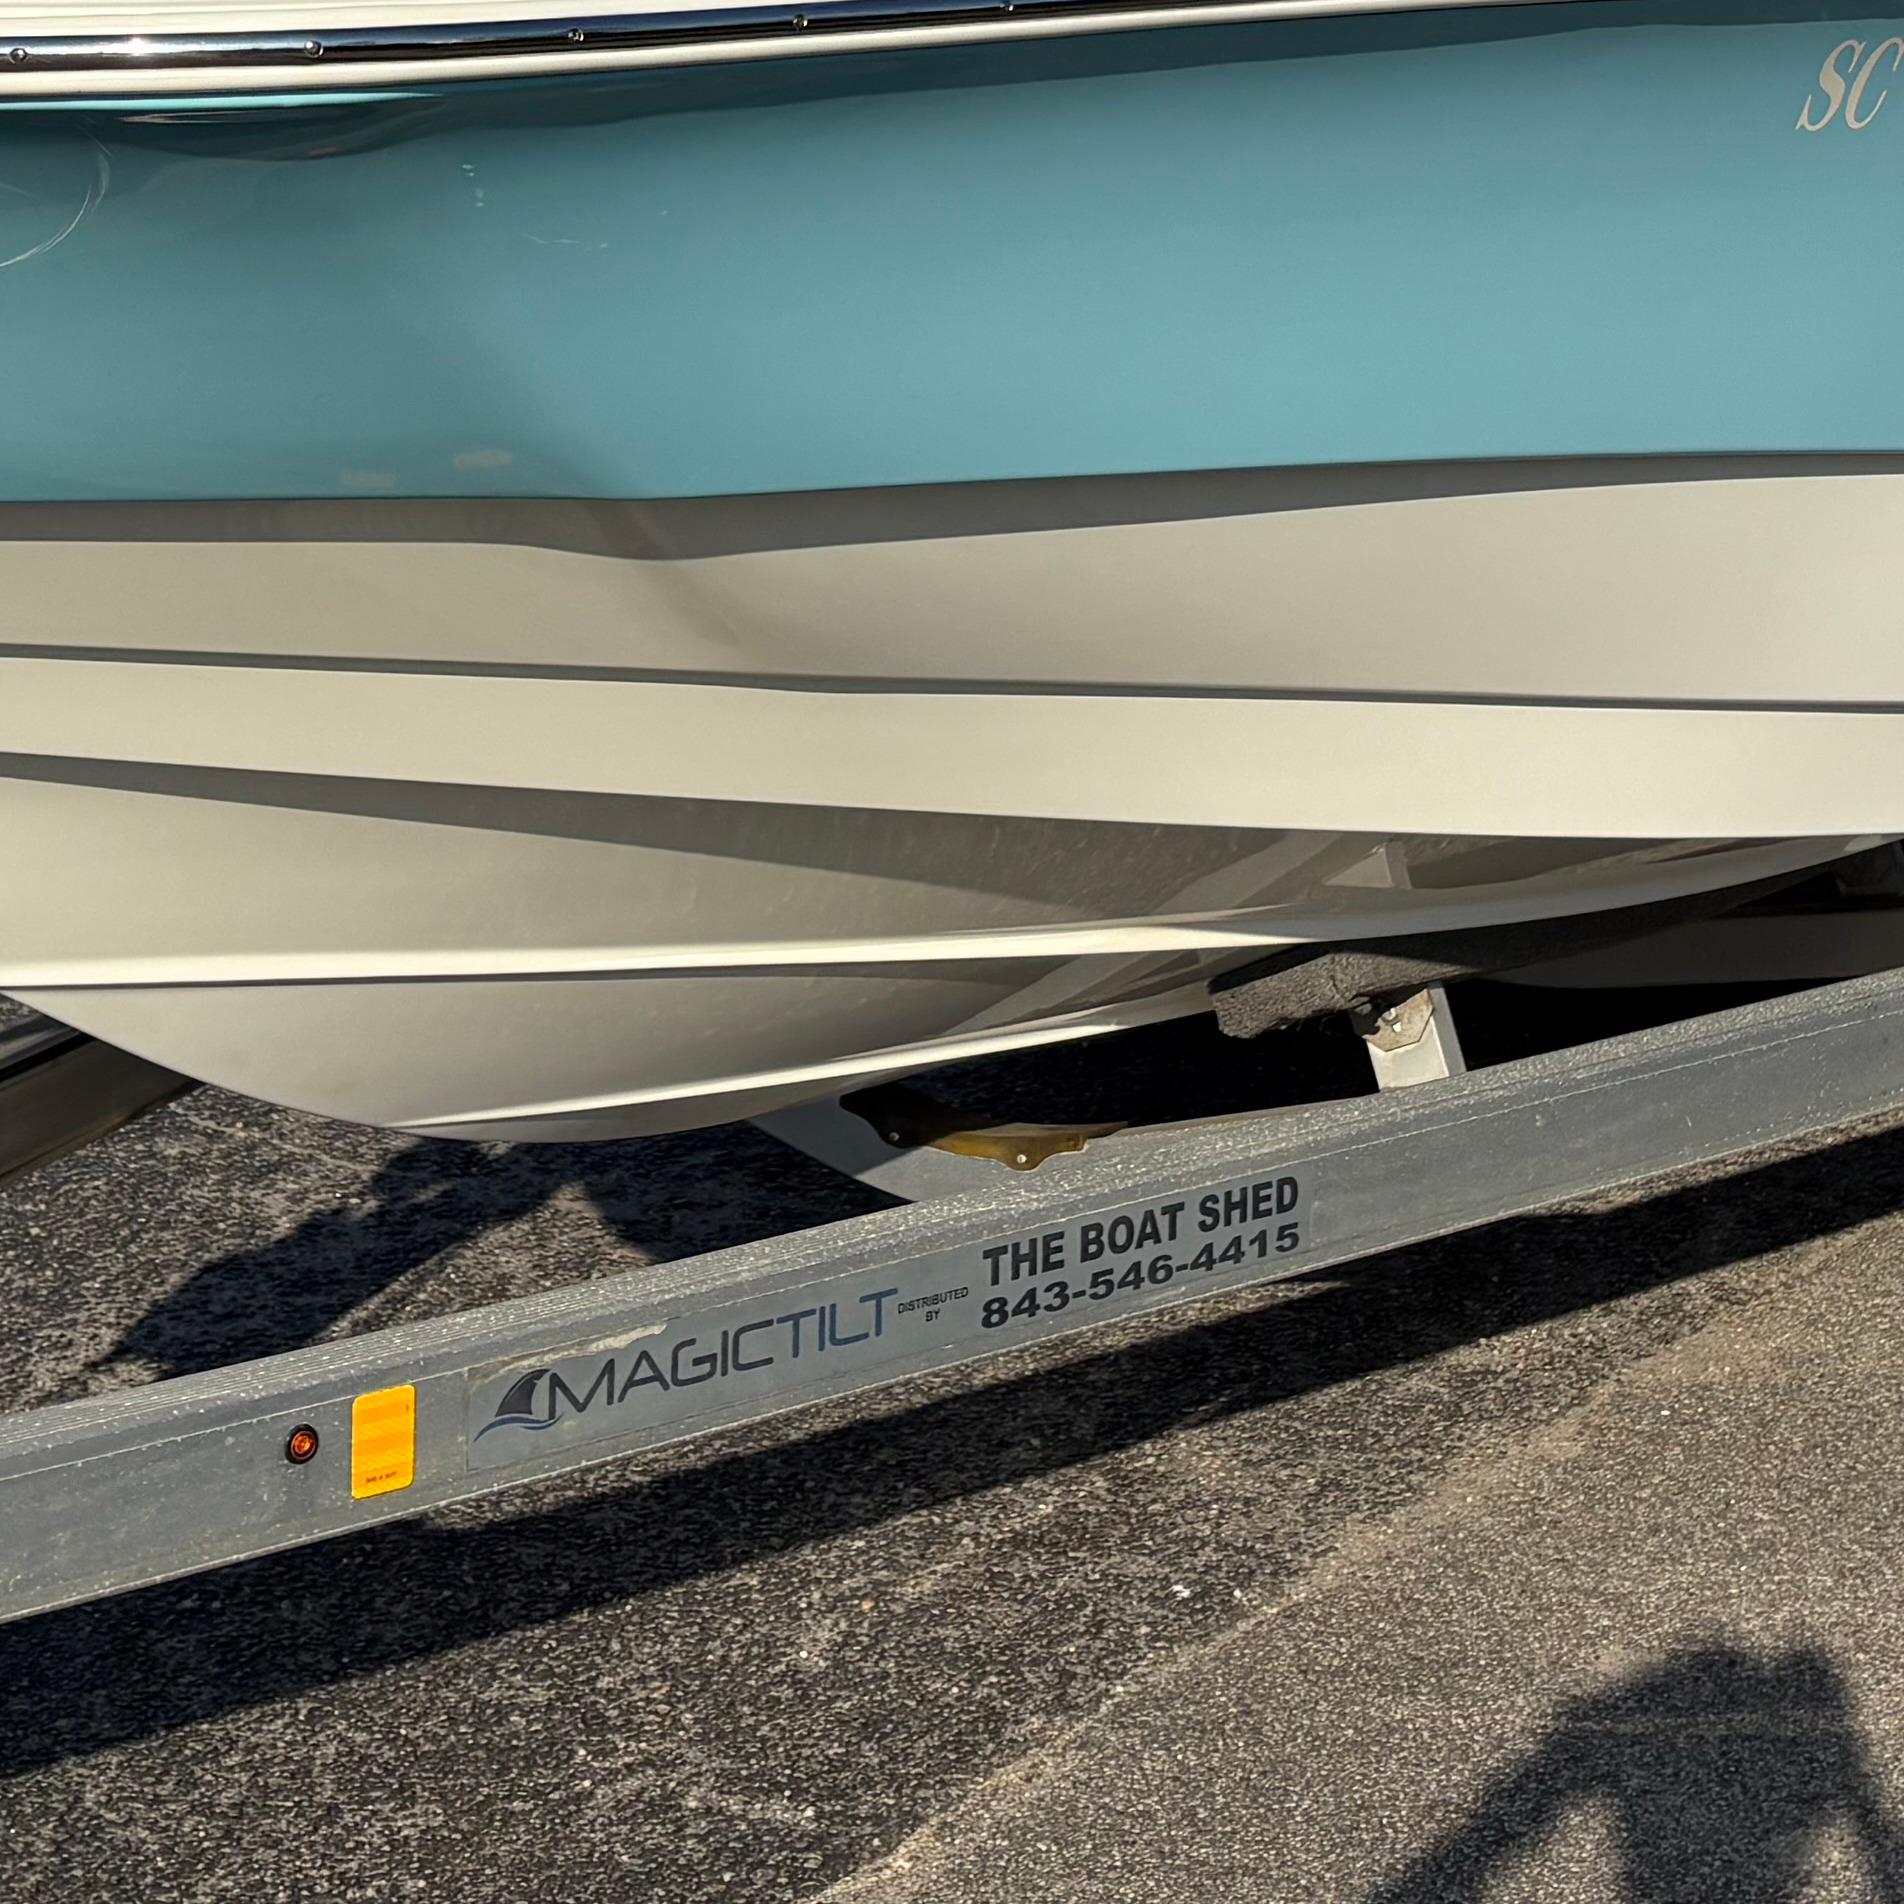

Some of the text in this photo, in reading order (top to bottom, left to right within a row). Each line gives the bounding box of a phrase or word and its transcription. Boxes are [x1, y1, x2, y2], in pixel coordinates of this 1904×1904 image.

[981, 1222, 1301, 1329] 843-546-4415
[982, 1175, 1299, 1286] THE BOAT SHED
[898, 1286, 969, 1314] DISTRIBUTED
[924, 1309, 940, 1322] BY
[548, 1288, 898, 1422] MAGICTILT
